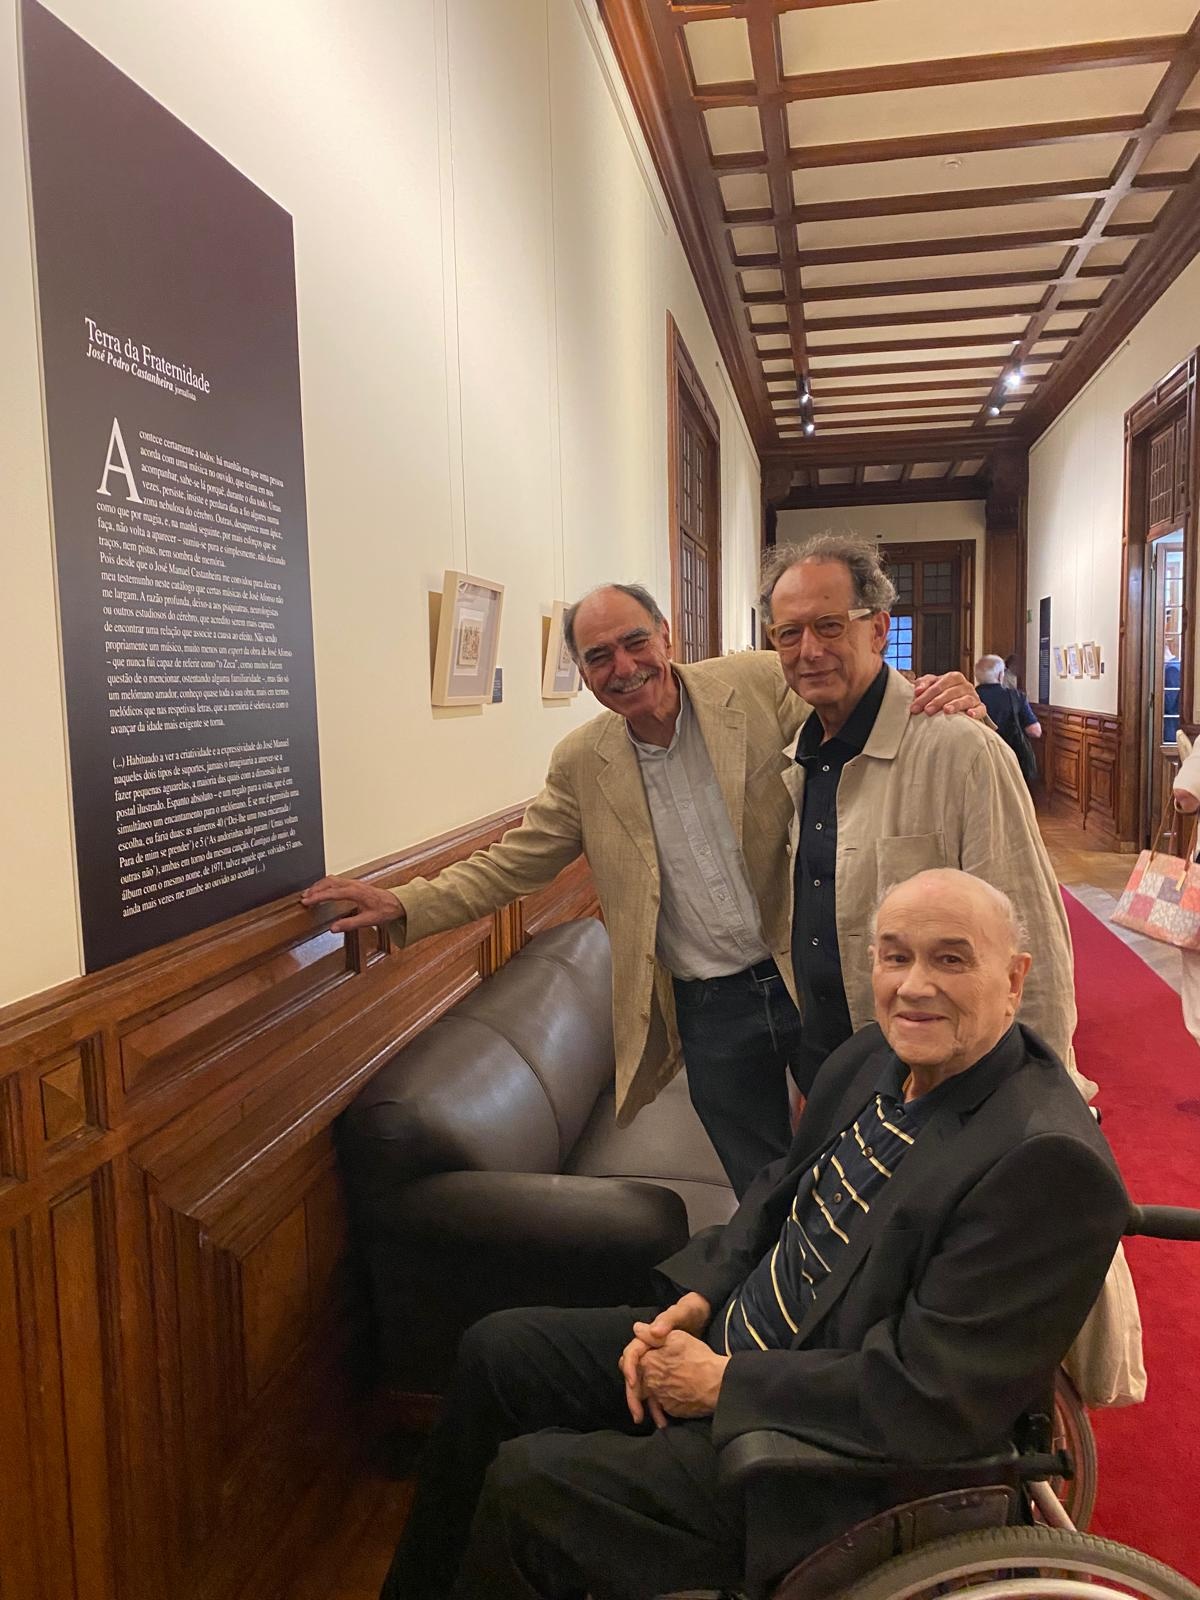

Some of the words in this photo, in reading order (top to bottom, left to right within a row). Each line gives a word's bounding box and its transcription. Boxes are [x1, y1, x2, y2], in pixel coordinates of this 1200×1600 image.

[84, 317, 121, 353] Terra
[124, 338, 139, 362] da
[142, 345, 210, 393] Fraternidade
[86, 343, 105, 361] José
[107, 351, 130, 372] Pedro
[138, 430, 163, 445] contece
[96, 416, 142, 503] A
[140, 447, 161, 460] acorda
[142, 496, 158, 507] zona
[96, 502, 116, 514] como
[116, 507, 129, 518] que
[130, 510, 142, 521] por
[97, 516, 115, 532] faça,
[115, 521, 128, 533] não
[129, 520, 145, 537] volta
[146, 529, 151, 538] a
[98, 536, 122, 550] traços,
[122, 541, 137, 551] nem
[99, 551, 115, 564] Pois
[116, 554, 135, 568] desde
[135, 560, 148, 571] que
[148, 562, 154, 570] o
[154, 560, 167, 573] José
[101, 572, 116, 581] meu
[117, 572, 154, 586] testemunho
[154, 579, 170, 589] neste
[102, 589, 113, 598] me
[114, 587, 139, 602] largam.
[139, 591, 146, 602] A
[146, 593, 163, 603] razão
[102, 606, 112, 615] ou
[113, 607, 134, 616] outros
[135, 606, 167, 619] estudiosos
[103, 620, 113, 632] de
[113, 624, 144, 634] encontrar
[145, 626, 159, 635] uma
[105, 638, 148, 652] propriamente
[149, 643, 159, 651] um
[112, 658, 125, 669] que
[126, 658, 145, 667] nunca
[146, 656, 155, 667] fui
[156, 659, 173, 670] capaz
[107, 672, 133, 686] questão
[133, 672, 142, 683] de
[142, 675, 148, 683] o
[108, 692, 120, 700] um
[120, 688, 154, 700] melómano
[109, 705, 143, 717] melódicos
[143, 707, 155, 718] que
[156, 706, 167, 715] nas
[110, 724, 136, 735] avançar
[137, 721, 145, 732] da
[146, 720, 163, 731] idade
[163, 718, 178, 730] mais
[126, 752, 159, 766] Habituado
[159, 754, 164, 762] a
[164, 752, 174, 761] ver
[113, 771, 142, 786] naqueles
[143, 768, 157, 780] dois
[157, 767, 172, 780] tipos
[114, 789, 131, 801] fazer
[132, 786, 162, 801] pequenas
[115, 804, 136, 821] postal
[116, 819, 152, 834] simultâneo
[152, 818, 163, 827] um
[145, 836, 154, 845] eu
[154, 830, 169, 842] faria
[119, 856, 135, 868] Para
[135, 852, 143, 863] de
[159, 848, 167, 857] se
[120, 872, 141, 884] outras
[161, 860, 180, 872] ambas
[121, 888, 142, 900] álbum
[142, 883, 157, 894] com
[157, 881, 163, 889] o
[163, 875, 184, 888] mesmo
[122, 902, 141, 917] ainda
[141, 897, 157, 911] mais
[157, 893, 175, 904] vezes
[175, 890, 184, 899] me
